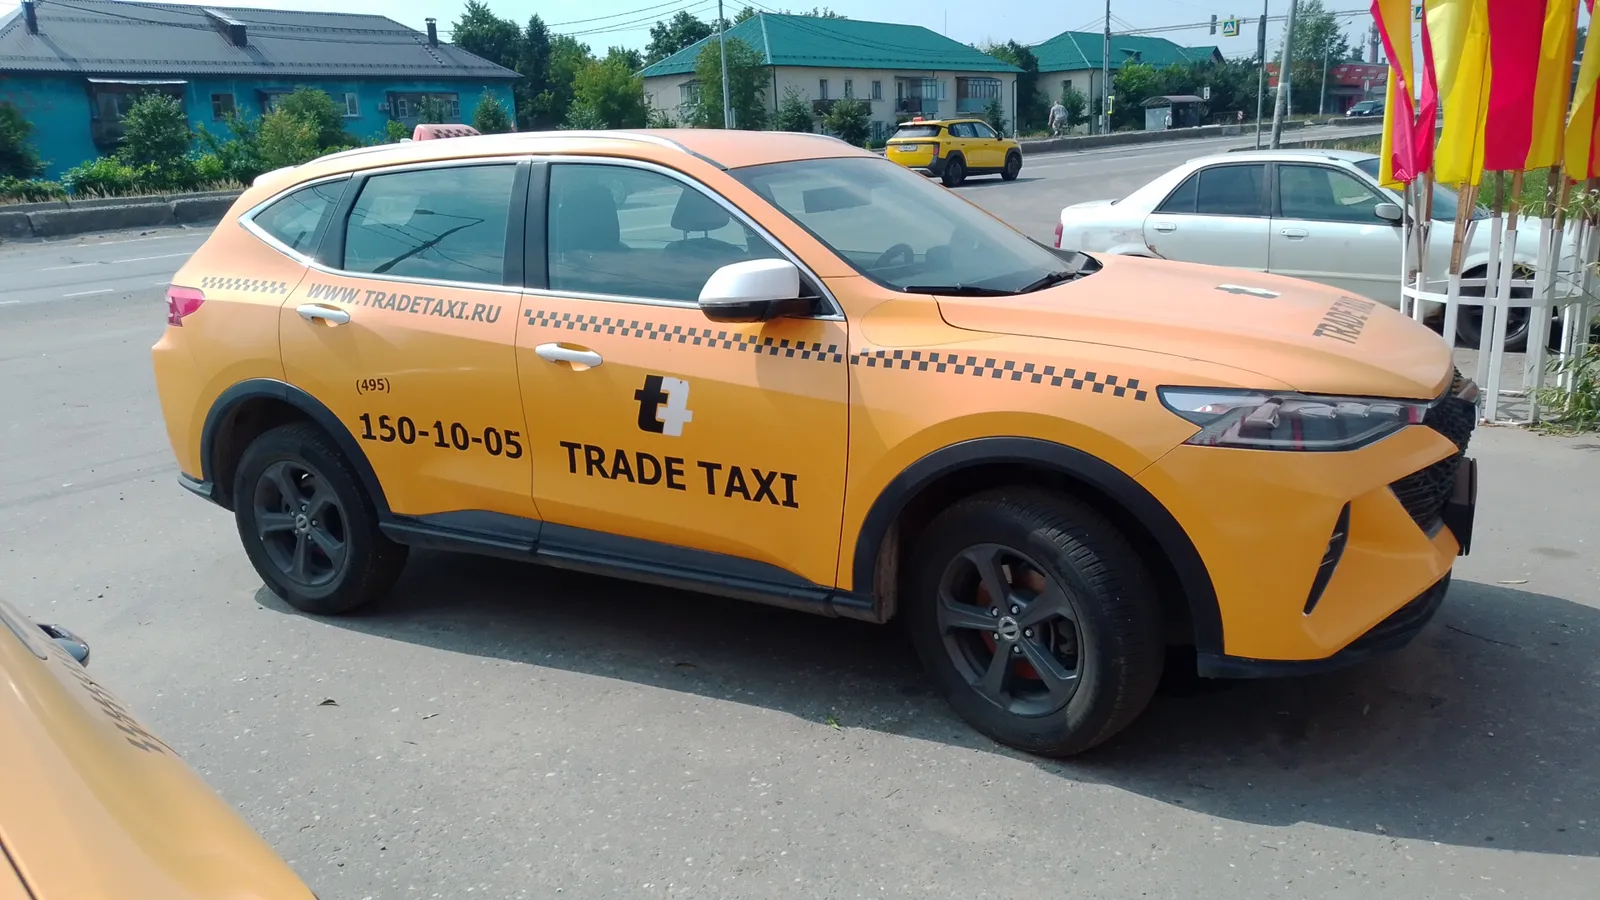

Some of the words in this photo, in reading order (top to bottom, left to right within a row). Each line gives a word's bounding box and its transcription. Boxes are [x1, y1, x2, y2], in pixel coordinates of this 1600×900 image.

[306, 282, 502, 324] WWW.TRADETAXI.RU
[1312, 306, 1369, 345] TRADE
[355, 377, 391, 395] (495)
[359, 412, 523, 459] 150-10-05
[559, 440, 687, 491] TRADE
[697, 460, 799, 509] TAXI
